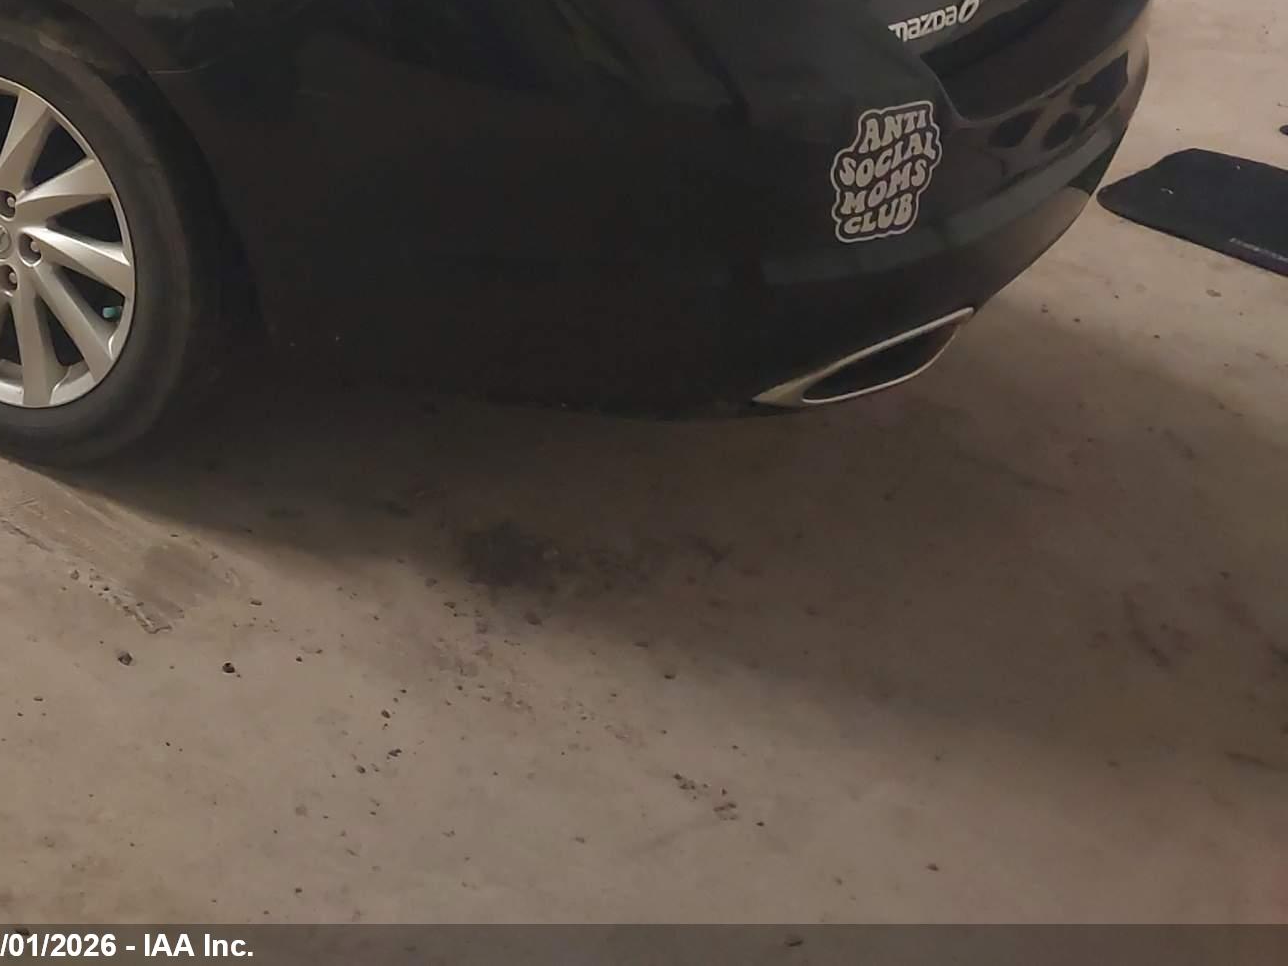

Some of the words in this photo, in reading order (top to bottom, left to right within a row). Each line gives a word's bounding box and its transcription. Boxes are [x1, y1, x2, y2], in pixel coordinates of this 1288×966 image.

[859, 109, 927, 153] ANTI
[839, 131, 936, 187] SOCIAL
[840, 159, 927, 214] MOMS
[843, 193, 913, 234] CLUB
